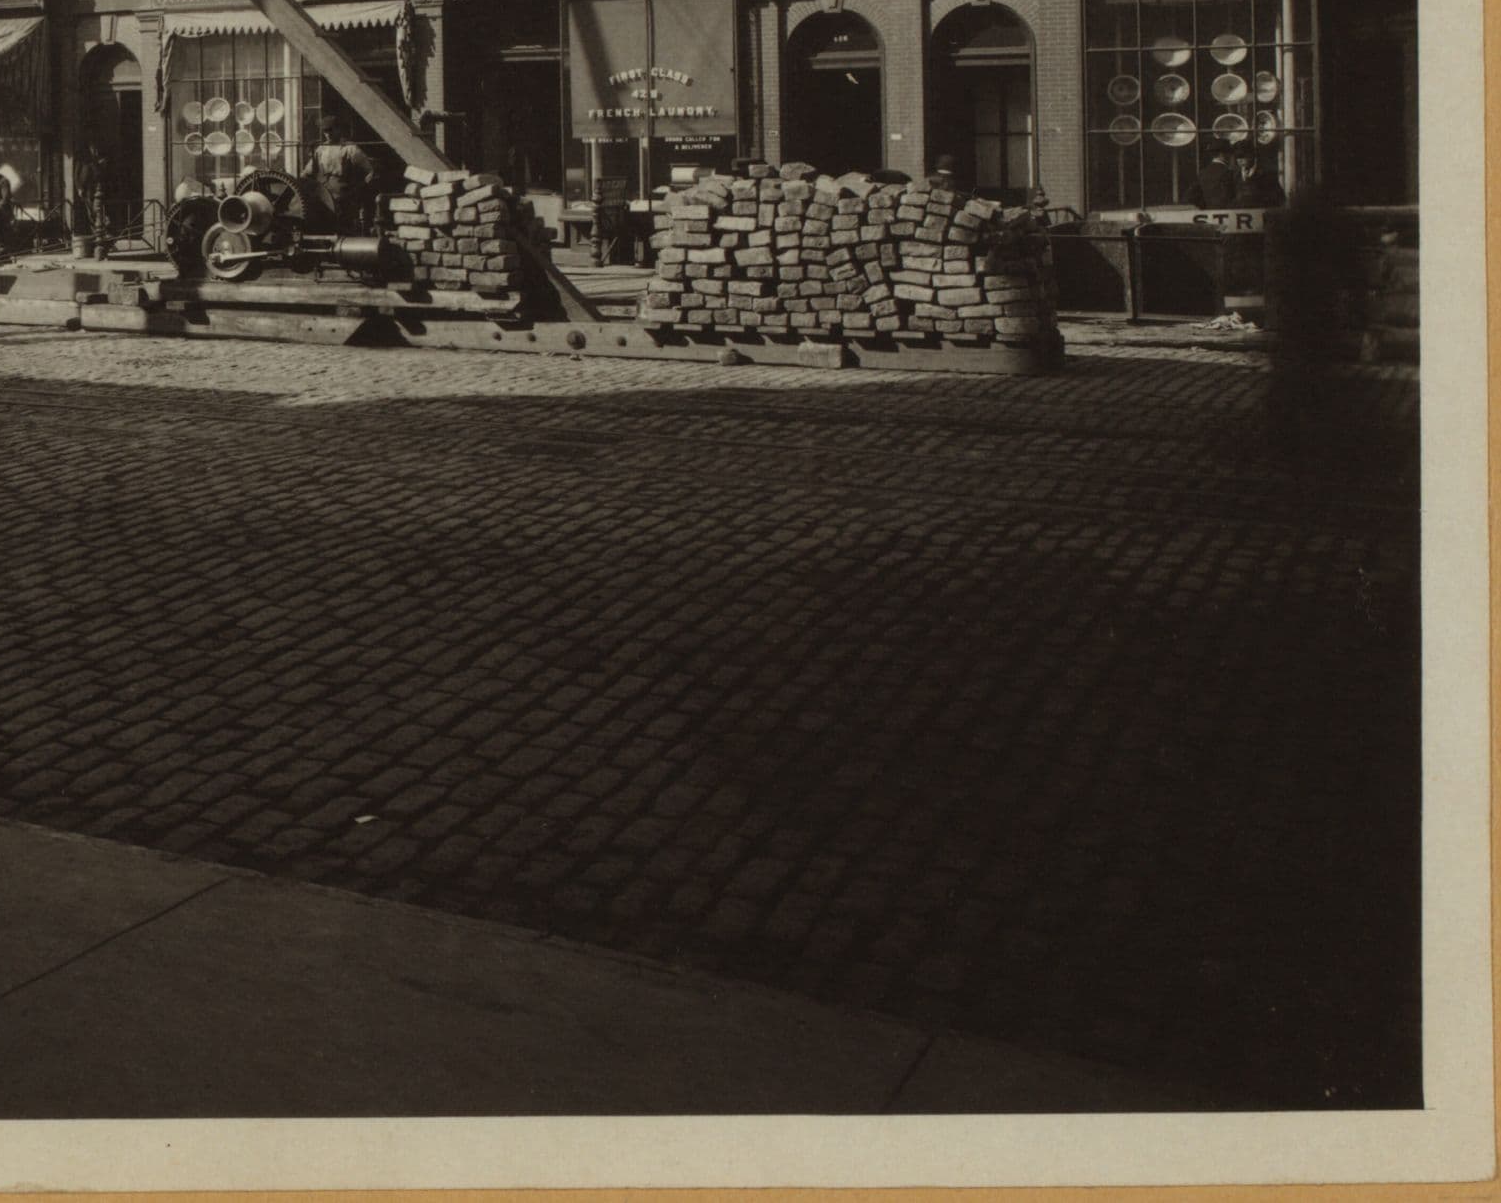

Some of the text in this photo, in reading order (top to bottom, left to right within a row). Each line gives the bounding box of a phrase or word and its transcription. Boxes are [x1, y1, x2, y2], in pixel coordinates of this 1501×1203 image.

[609, 67, 690, 86] FIRST CLASS
[588, 108, 641, 118] FRENCH
